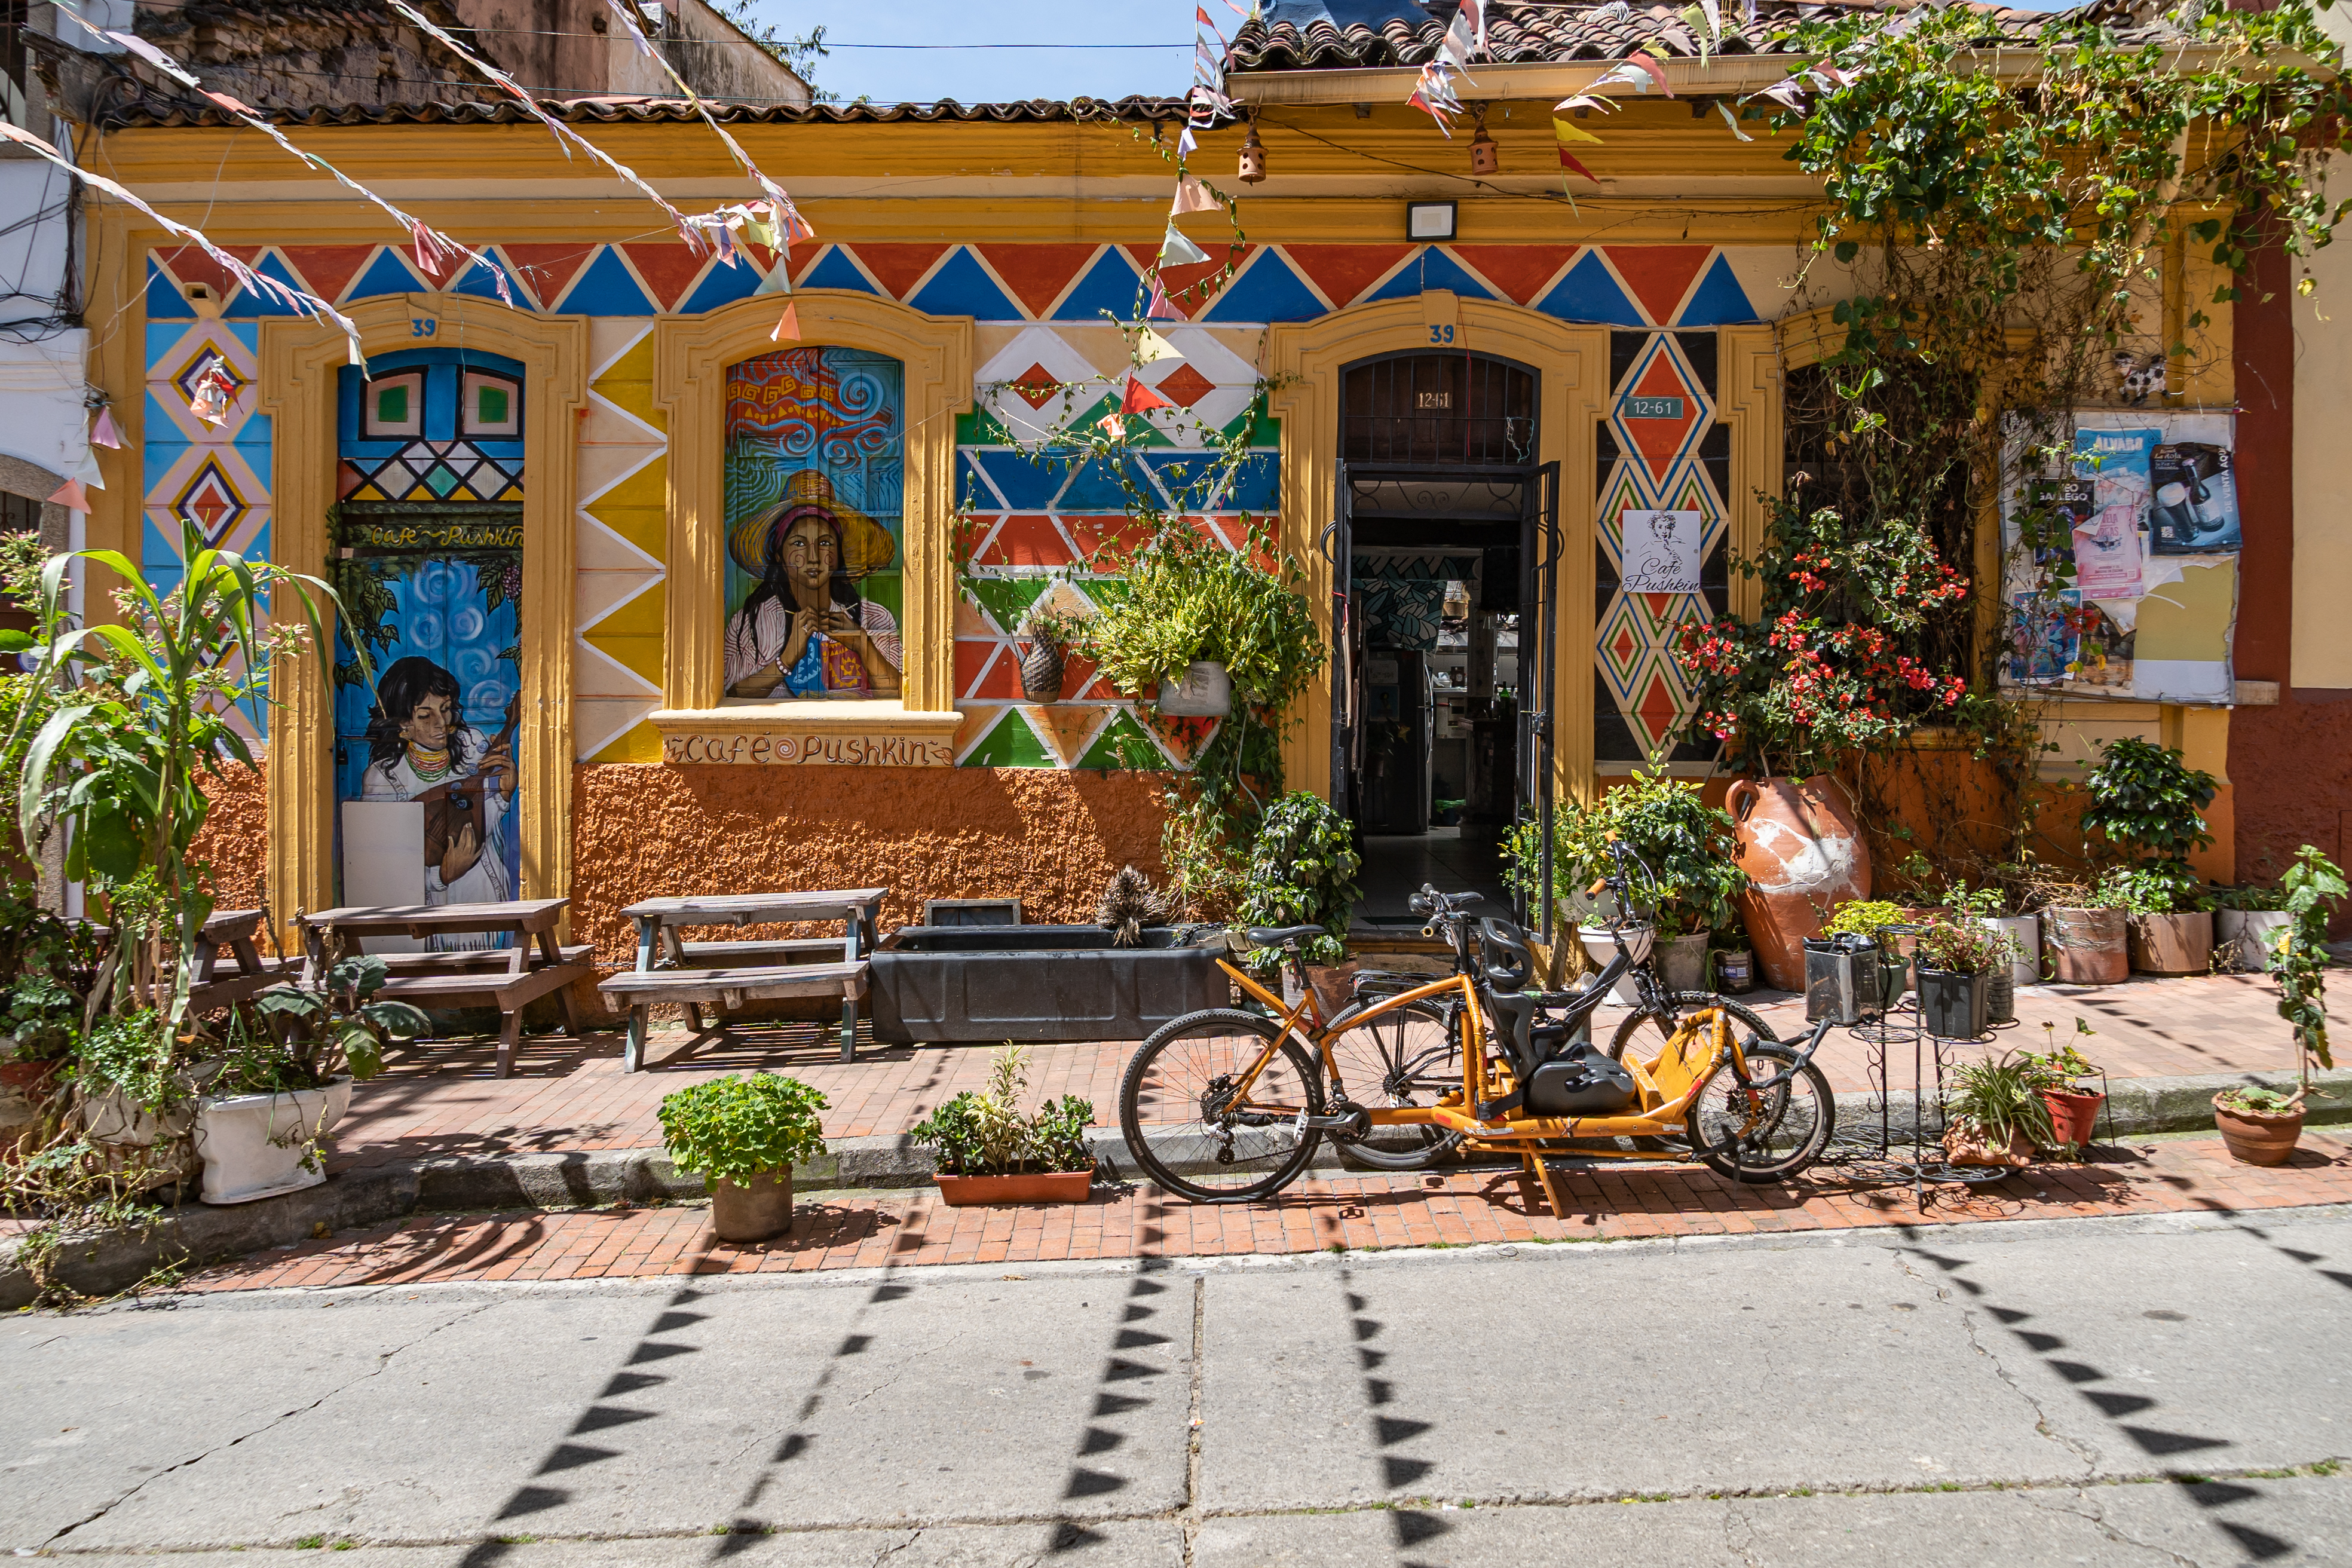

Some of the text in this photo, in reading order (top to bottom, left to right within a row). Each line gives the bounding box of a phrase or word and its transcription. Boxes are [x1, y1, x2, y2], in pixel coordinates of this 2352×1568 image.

[412, 318, 436, 337] 39
[1429, 324, 1454, 343] 39
[1419, 392, 1448, 408] 12-61
[1634, 402, 1671, 414] 12-61
[2221, 470, 2231, 498] VENTA
[372, 525, 422, 547] Café
[1641, 558, 1683, 578] Café
[1622, 574, 1701, 593] Pushkin
[684, 731, 771, 764] Café
[1296, 1058, 1318, 1104] MAXXIS
